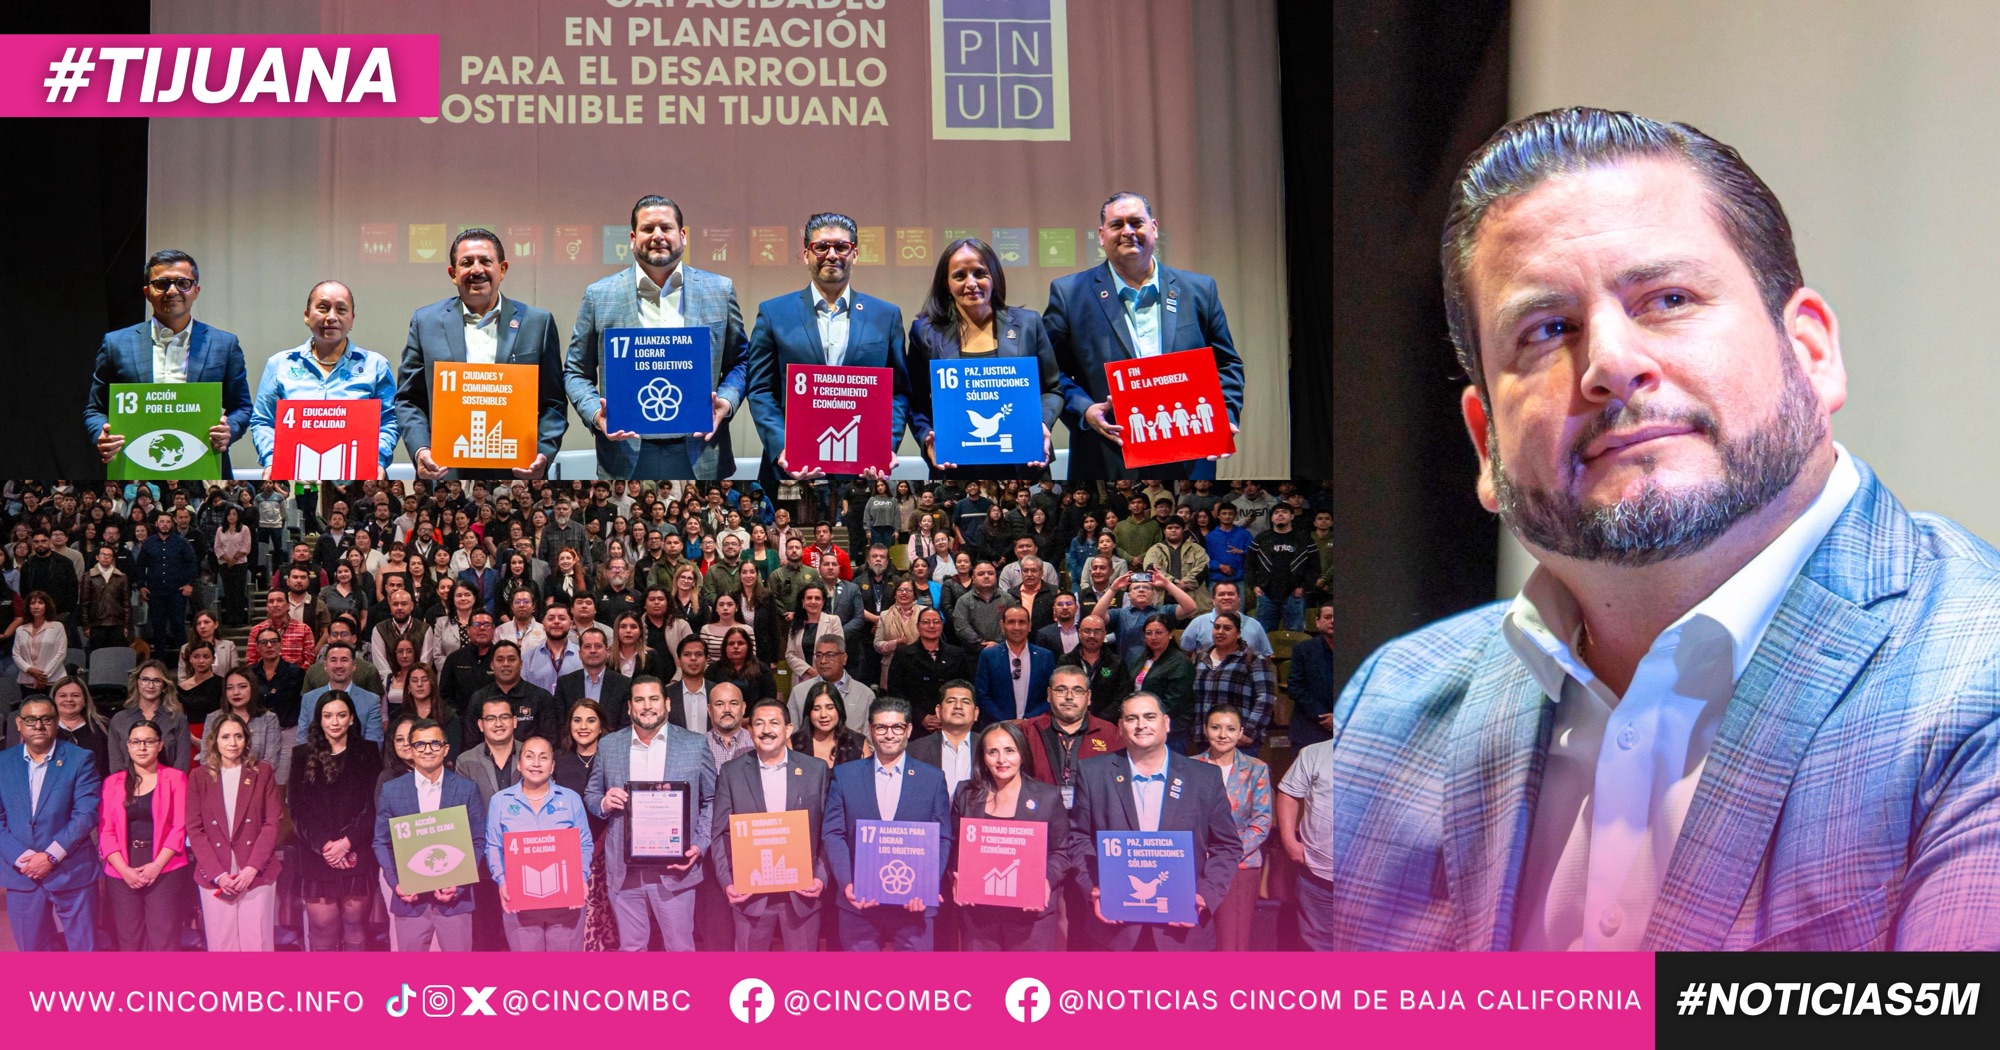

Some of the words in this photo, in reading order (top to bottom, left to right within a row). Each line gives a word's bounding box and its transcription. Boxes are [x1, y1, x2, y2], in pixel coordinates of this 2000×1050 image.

[565, 17, 612, 46] EN
[628, 10, 886, 48] PLANEACIÓN
[460, 56, 565, 85] PARA
[579, 56, 617, 85] EL
[631, 56, 887, 87] DESARROLLO
[419, 94, 643, 124] OSTENIBLE
[658, 95, 706, 125] EN
[719, 95, 889, 126] TIJUANA
[634, 336, 670, 345] ALIANZAS
[672, 335, 693, 344] PARA
[610, 336, 630, 358] 17
[634, 348, 665, 358] LOGRAR
[635, 361, 650, 370] LOS
[652, 360, 693, 370] OBJETIVOS
[463, 371, 497, 380] CIUDADES
[498, 372, 504, 381] Y
[964, 367, 981, 376] PAZ,
[983, 366, 1017, 376] JUSTICIA
[1127, 367, 1141, 377] FIN
[440, 370, 456, 391] 11
[794, 372, 807, 395] 8
[813, 373, 845, 384] TRABAJO
[847, 375, 878, 385] DECENTE
[936, 367, 959, 389] 16
[965, 379, 970, 388] E
[972, 378, 1029, 388] INSTITUCIONES
[1112, 369, 1125, 391] 1
[1130, 380, 1142, 390] DE
[1142, 378, 1152, 388] LA
[1152, 372, 1189, 386] POBREZA
[462, 383, 513, 394] COMUNIDADES
[813, 386, 818, 395] Y
[819, 386, 868, 397] CRECIMIENTO
[145, 389, 177, 401] ACCIÓN
[462, 395, 507, 406] SOSTENIBLES
[966, 390, 999, 401] SÓLIDAS
[115, 392, 138, 414] 13
[145, 403, 162, 414] POR
[164, 403, 174, 413] EL
[175, 402, 201, 413] CLIMA
[812, 398, 856, 410] ECONÓMICO
[302, 406, 347, 417] EDUCACIÓN
[282, 407, 296, 429] 4
[301, 420, 311, 429] DE
[313, 419, 346, 429] CALIDAD
[394, 821, 411, 840] 13
[415, 827, 429, 837] POR
[429, 826, 436, 834] EL
[436, 822, 455, 833] CLIMA
[734, 820, 748, 838] 11
[860, 826, 877, 843] 17
[879, 826, 908, 835] ALIANZAS
[909, 827, 926, 836] PARA
[966, 824, 977, 842] 8
[981, 825, 1008, 834] TRABAJO
[1008, 826, 1035, 836] DECENTE
[523, 834, 556, 844] EDUCACIÓN
[879, 836, 904, 845] LOGRAR
[981, 835, 986, 843] Y
[986, 836, 1026, 846] CRECIMIENTO
[1126, 838, 1142, 847] PAZ,
[1143, 838, 1174, 847] JUSTICIA
[509, 838, 519, 855] 4
[523, 846, 532, 854] DE
[532, 845, 556, 853] CALIDAD
[878, 846, 890, 854] LOS
[891, 846, 925, 856] OBJETIVOS
[1102, 837, 1122, 857] 16
[1127, 848, 1132, 857] E
[1133, 849, 1185, 858] INSTITUCIONES
[1127, 857, 1157, 868] SÓLIDAS
